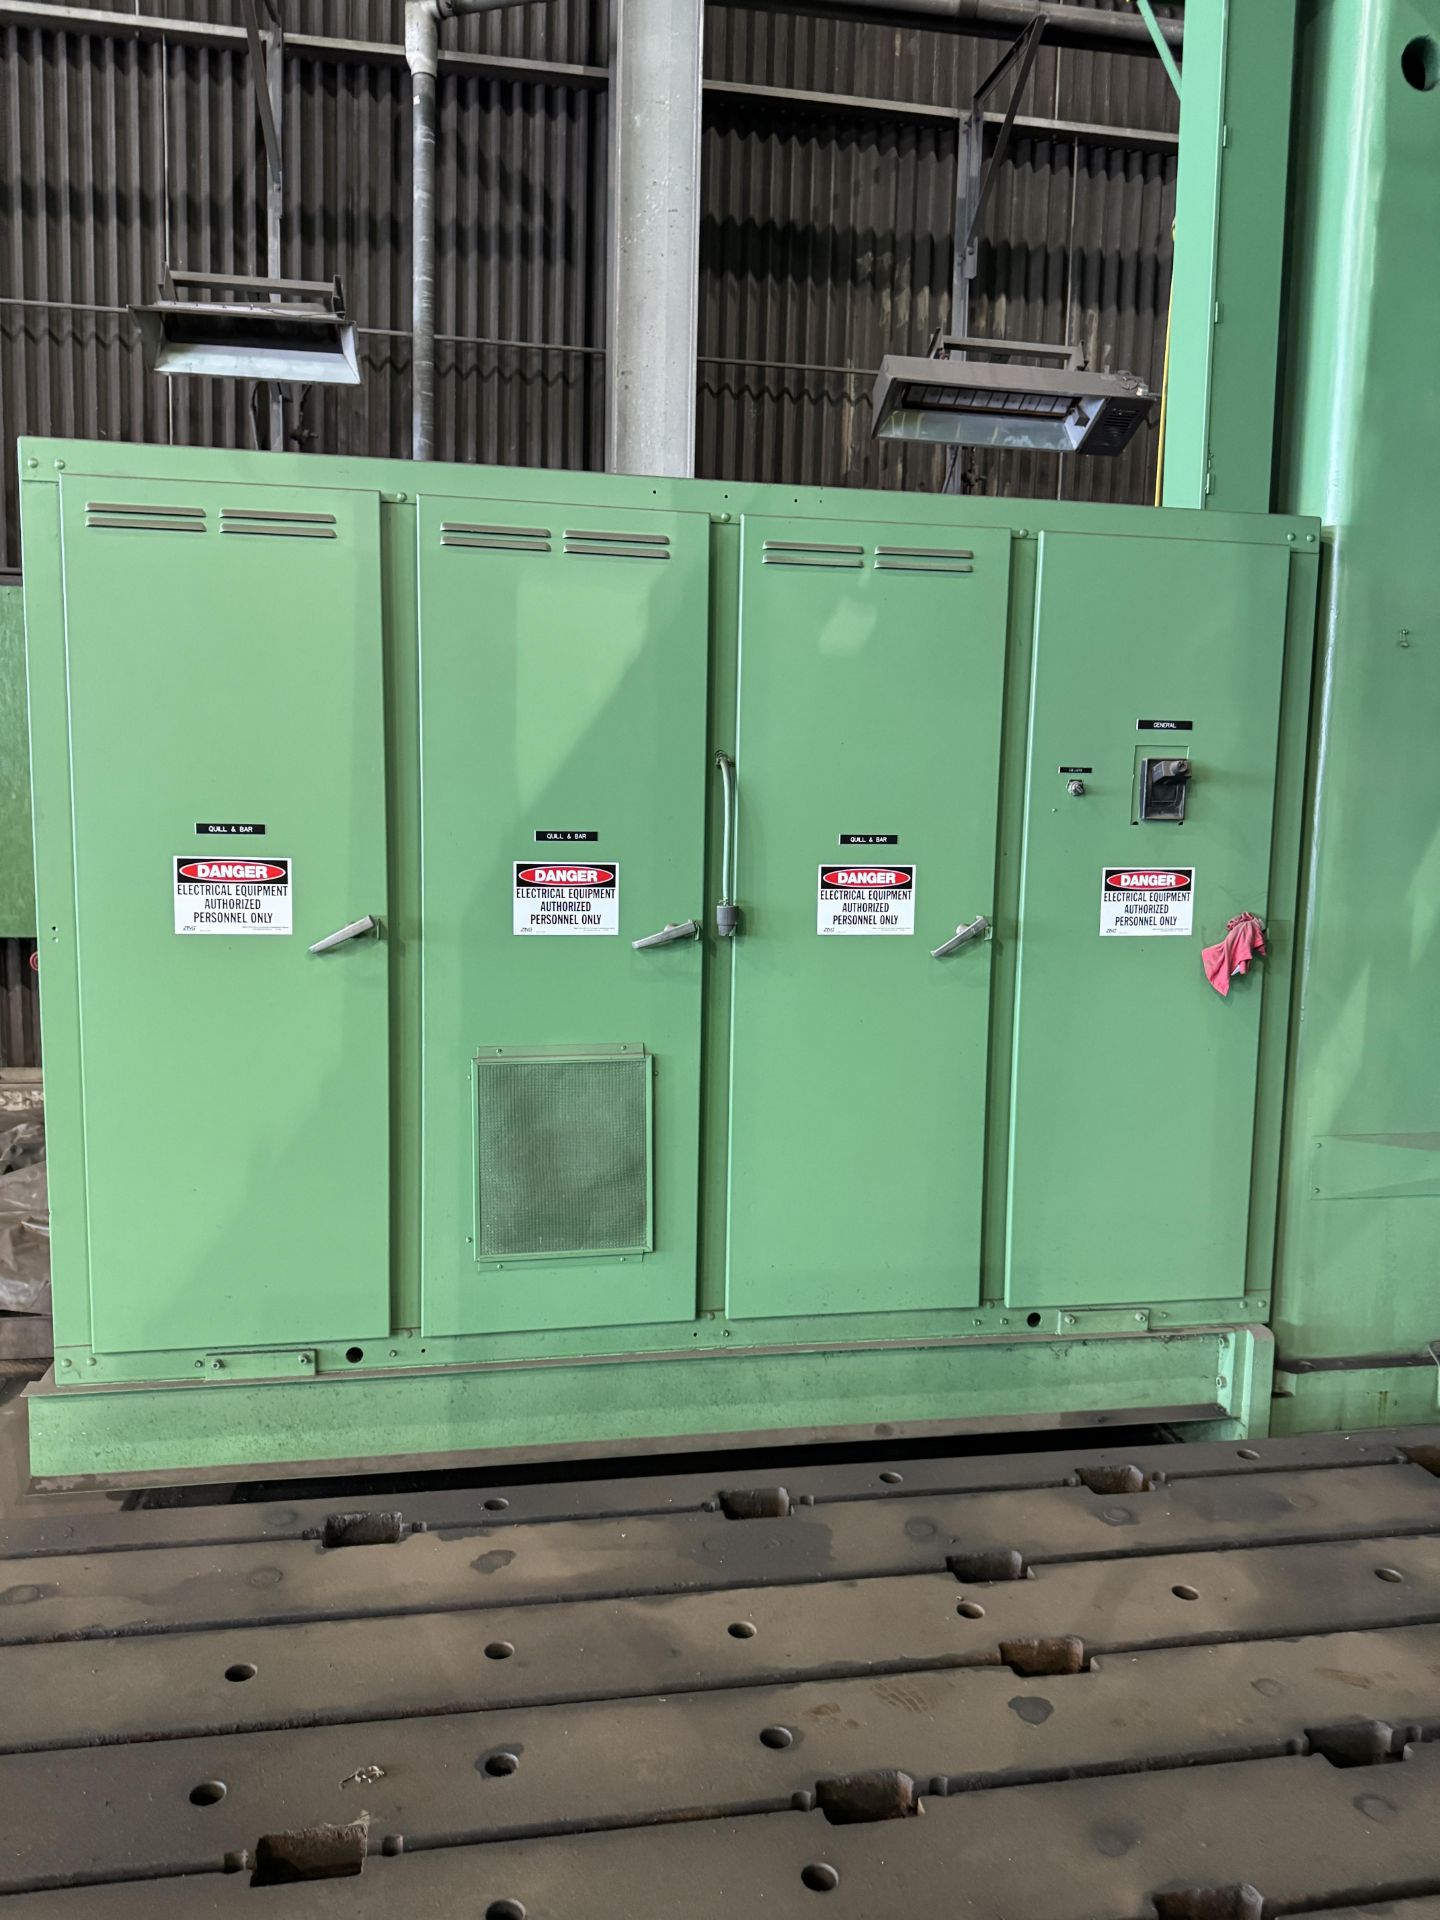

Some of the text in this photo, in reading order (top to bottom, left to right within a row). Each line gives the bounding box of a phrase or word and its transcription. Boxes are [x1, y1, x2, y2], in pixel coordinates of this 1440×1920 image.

[198, 865, 267, 878] DANGER
[535, 870, 597, 881] DANGER
[838, 873, 896, 883] DANGER
[1121, 875, 1175, 886] DANGER
[178, 885, 288, 897] ELECTRICAL EQUIPMENT
[517, 889, 615, 899] ELECTRICAL EQUIPMENT
[821, 891, 912, 901] ELECTRICAL EQUIPMENT
[1104, 893, 1190, 902] ELECTRICAL EQUIPMENT
[205, 899, 260, 909] AUTHORIZED
[541, 902, 591, 911] AUTHORIZED
[842, 903, 889, 912] AUTHORIZED
[1124, 905, 1168, 913] AUTHORIZED
[194, 912, 273, 923] PERSONNEL ONLY
[531, 914, 601, 924] PERSONNEL ONLY
[833, 915, 898, 924] PERSONNEL ONLY
[1115, 917, 1177, 926] PERSONNEL ONLY
